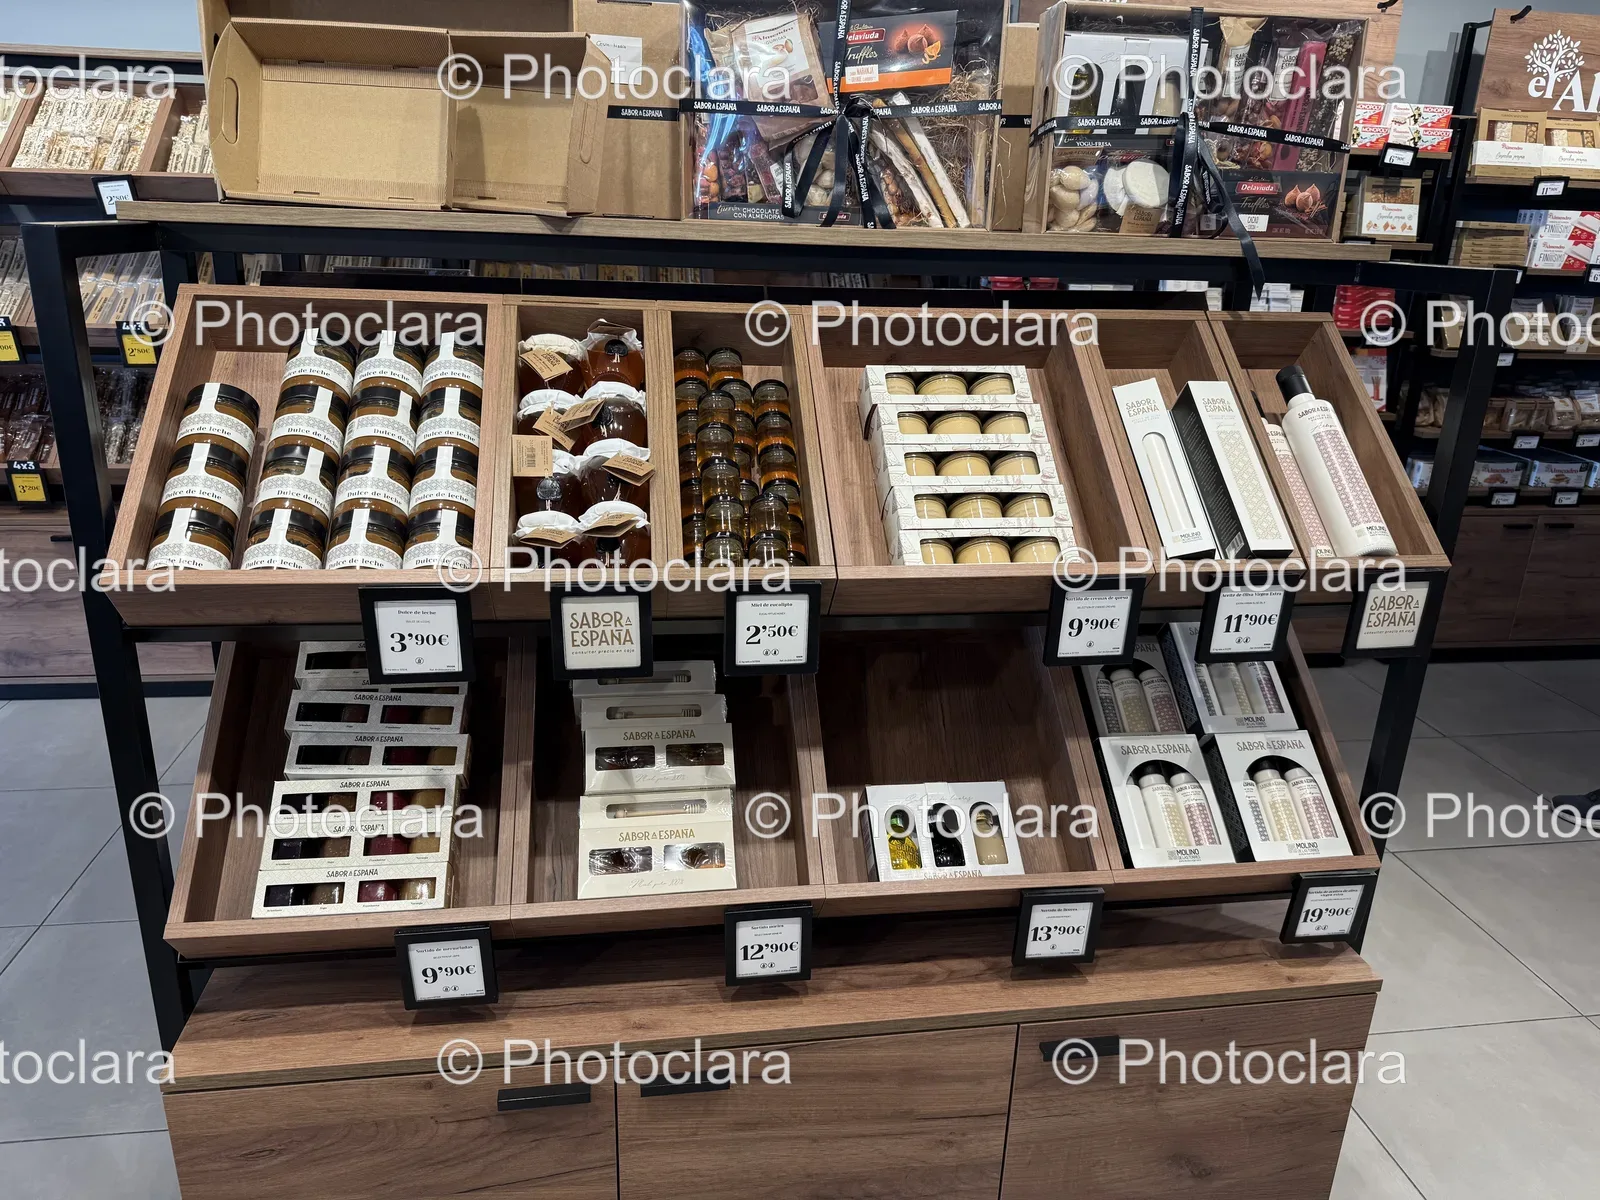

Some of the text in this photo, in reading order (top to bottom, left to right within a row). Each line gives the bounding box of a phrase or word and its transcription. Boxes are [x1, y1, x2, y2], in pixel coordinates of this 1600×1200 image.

[846, 31, 879, 41] elaviuda
[1192, 28, 1200, 49] SABOR
[693, 101, 712, 110] SABOR
[756, 104, 775, 112] SABOR
[911, 106, 930, 114] SABOR
[978, 102, 997, 111] SABOR
[1423, 106, 1452, 114] MONOPOLY
[621, 108, 639, 117] SABOR
[1077, 118, 1095, 127] SABOR
[1227, 124, 1245, 134] SABOR
[1361, 126, 1389, 134] MONOPOLY
[1423, 129, 1451, 137] MONOPOLY
[1284, 133, 1301, 143] SABOR
[1182, 164, 1193, 185] SABOR
[1240, 184, 1274, 192] Delaviuda
[748, 213, 785, 221] ALMENDRAS
[1125, 398, 1153, 411] SABOR
[1202, 397, 1227, 405] SABOR
[1127, 404, 1160, 418] ESPAÑA
[1204, 404, 1234, 413] ESPAÑA
[208, 427, 232, 436] leche
[287, 427, 322, 438] Dulce de
[373, 428, 397, 437] Dulce
[423, 431, 443, 440] Dulce
[455, 431, 476, 442] leche
[13, 461, 35, 470] 4x3
[199, 489, 222, 500] leche
[276, 489, 301, 497] Dulce
[347, 489, 369, 498] Dulce
[370, 489, 382, 497] de
[447, 492, 469, 503] leche
[279, 558, 303, 569] leche
[361, 558, 385, 568] leche
[415, 557, 438, 566] Dulce
[1370, 595, 1414, 612] SABOR
[570, 611, 624, 629] SABOR
[1223, 613, 1278, 633] 11'90€
[1366, 611, 1416, 628] ESPAÑA
[1067, 617, 1120, 638] 9'90€
[571, 629, 634, 648] ESPAÑA
[745, 624, 799, 645] 2'50€
[390, 632, 450, 653] 3'90€
[354, 735, 375, 743] SABOR
[622, 729, 696, 741] SABOR ESPAÑA
[1121, 743, 1192, 756] SABOR ESPAÑA
[1236, 739, 1305, 751] SABOR ESPAÑA
[339, 779, 391, 789] SABOR ESPAÑA
[618, 828, 695, 842] SABOR ESPAÑA
[1295, 841, 1319, 849] MOLINO
[1176, 848, 1200, 856] MOLINO
[326, 868, 379, 878] SABOR ESPAÑA
[954, 870, 983, 879] ESPAÑA
[1301, 907, 1354, 924] 19'90€
[1030, 925, 1086, 943] 13'90€
[740, 941, 799, 961] 12'90€
[421, 964, 477, 985] 9'90€
